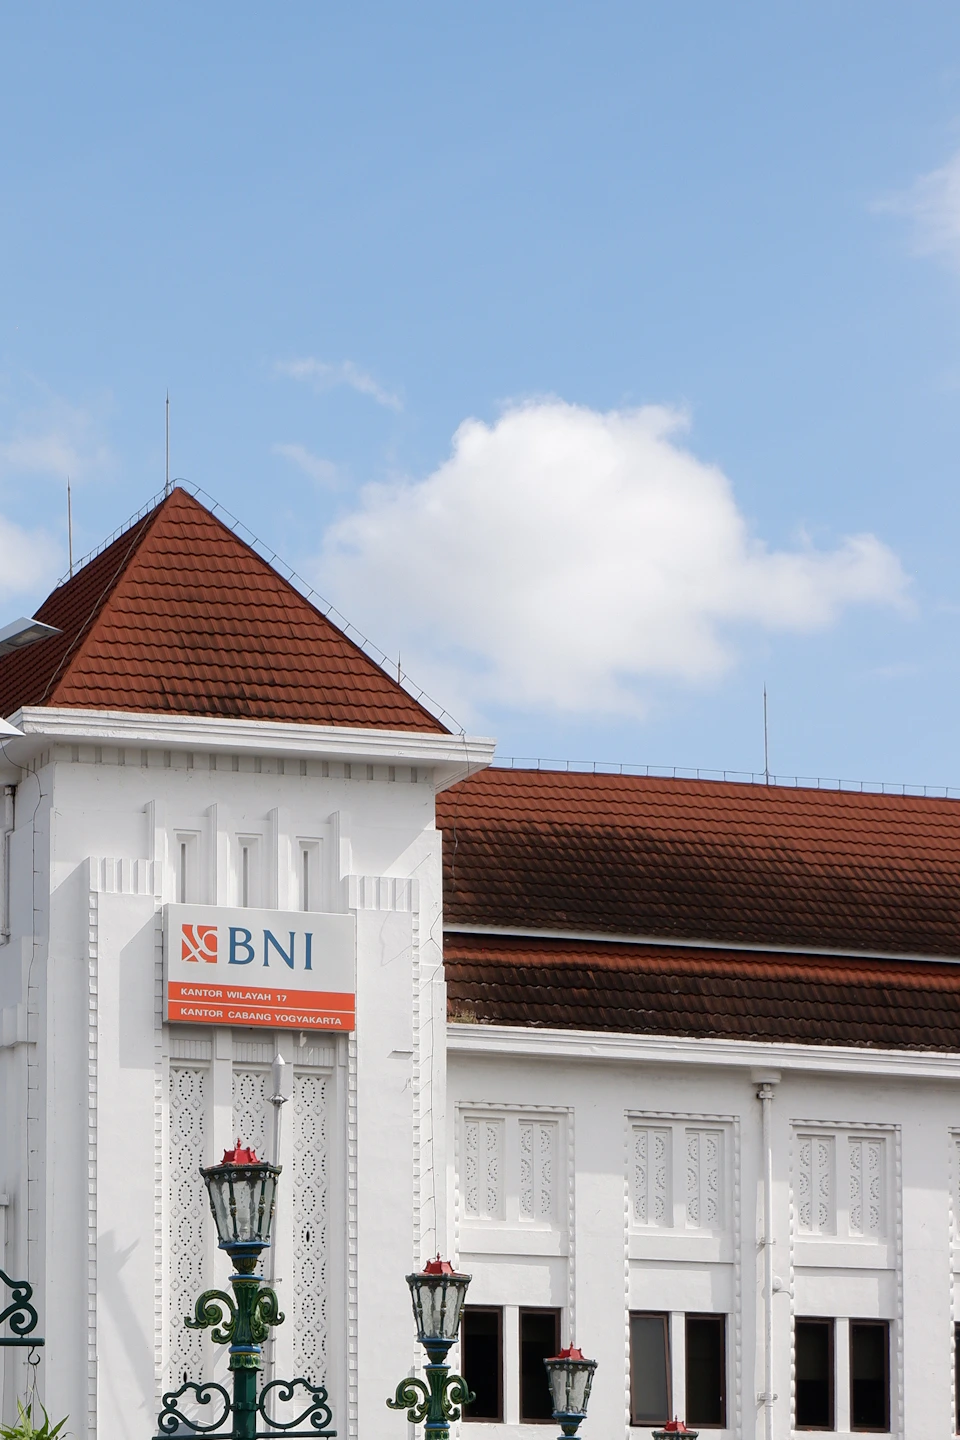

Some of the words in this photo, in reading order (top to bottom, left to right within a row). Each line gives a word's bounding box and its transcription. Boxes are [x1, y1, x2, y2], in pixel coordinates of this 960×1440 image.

[228, 927, 313, 970] BNI
[180, 988, 223, 998] KANTOR
[227, 991, 271, 1001] WILAYAH
[276, 994, 287, 1002] 17
[180, 1007, 223, 1018] KANTOR
[228, 1011, 271, 1021] CABANG
[274, 1014, 342, 1025] YOGYAKARTA
